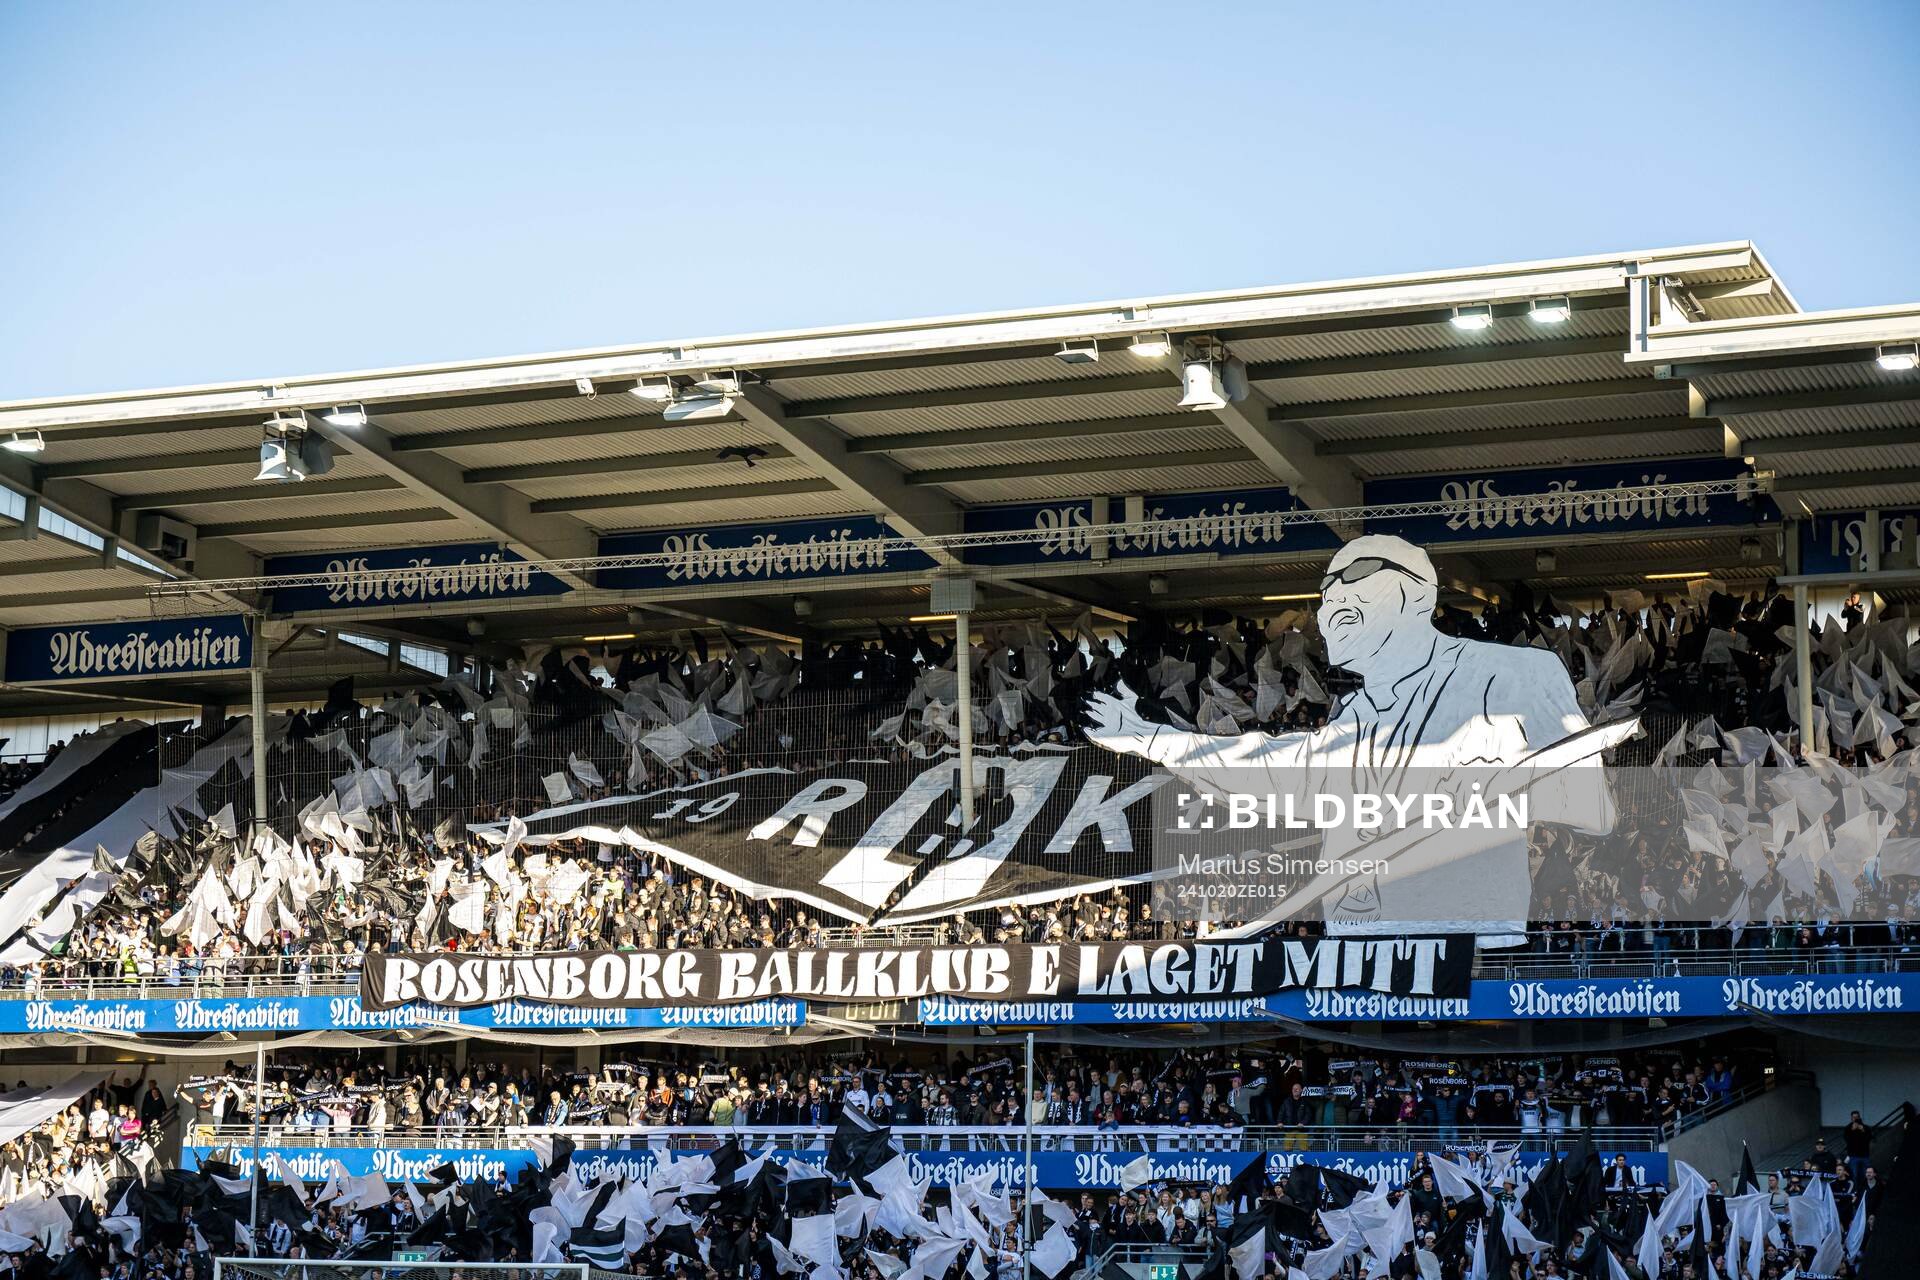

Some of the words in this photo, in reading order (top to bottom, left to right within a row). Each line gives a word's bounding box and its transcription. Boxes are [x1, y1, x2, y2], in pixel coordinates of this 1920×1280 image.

[50, 627, 241, 674] Adresseavisen
[382, 950, 702, 1003] ROSENBORG
[717, 945, 1011, 1000] BALLKLUB
[1026, 944, 1062, 995] E
[1076, 942, 1263, 995] LAGET
[1283, 938, 1446, 995] MITT
[1509, 981, 1681, 1016] Adresseavisen
[1723, 979, 1902, 1012] Adresseavisen
[26, 1001, 145, 1030] Adresseavisen
[175, 999, 299, 1028] Adresseavisen
[1405, 1061, 1454, 1069] ROSENBORG
[1429, 1077, 1467, 1085] ROSENBORG
